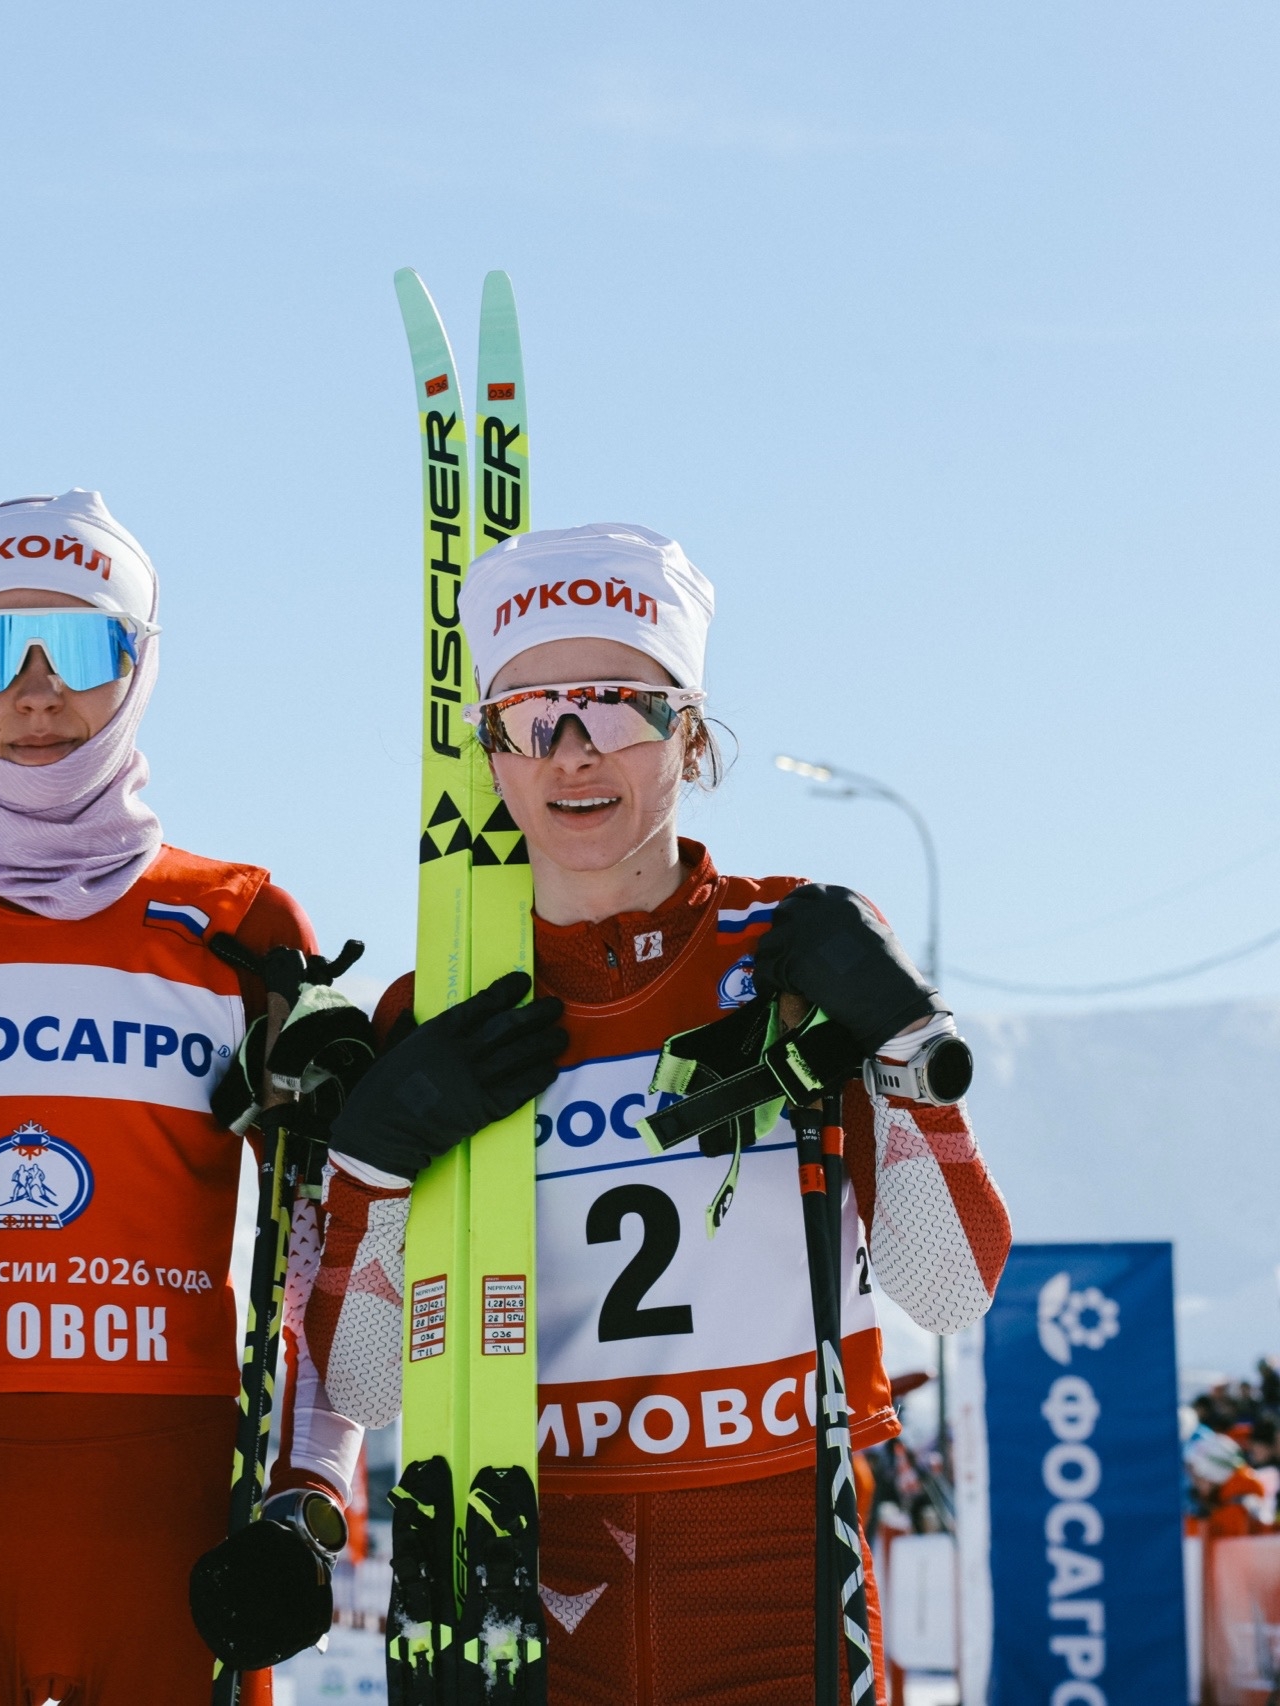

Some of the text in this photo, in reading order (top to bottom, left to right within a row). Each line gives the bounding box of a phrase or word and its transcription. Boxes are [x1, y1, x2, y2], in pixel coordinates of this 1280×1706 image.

[488, 388, 513, 400] 036
[426, 410, 462, 760] FISCHER
[493, 577, 658, 636] ЛУКОЙЛ
[67, 1256, 150, 1286] 2026
[156, 1267, 213, 1294] года
[585, 1183, 694, 1343] 2
[856, 1247, 873, 1296] 2
[415, 1285, 444, 1297] NEPRYAEVA
[537, 1369, 856, 1458] ИРОВС
